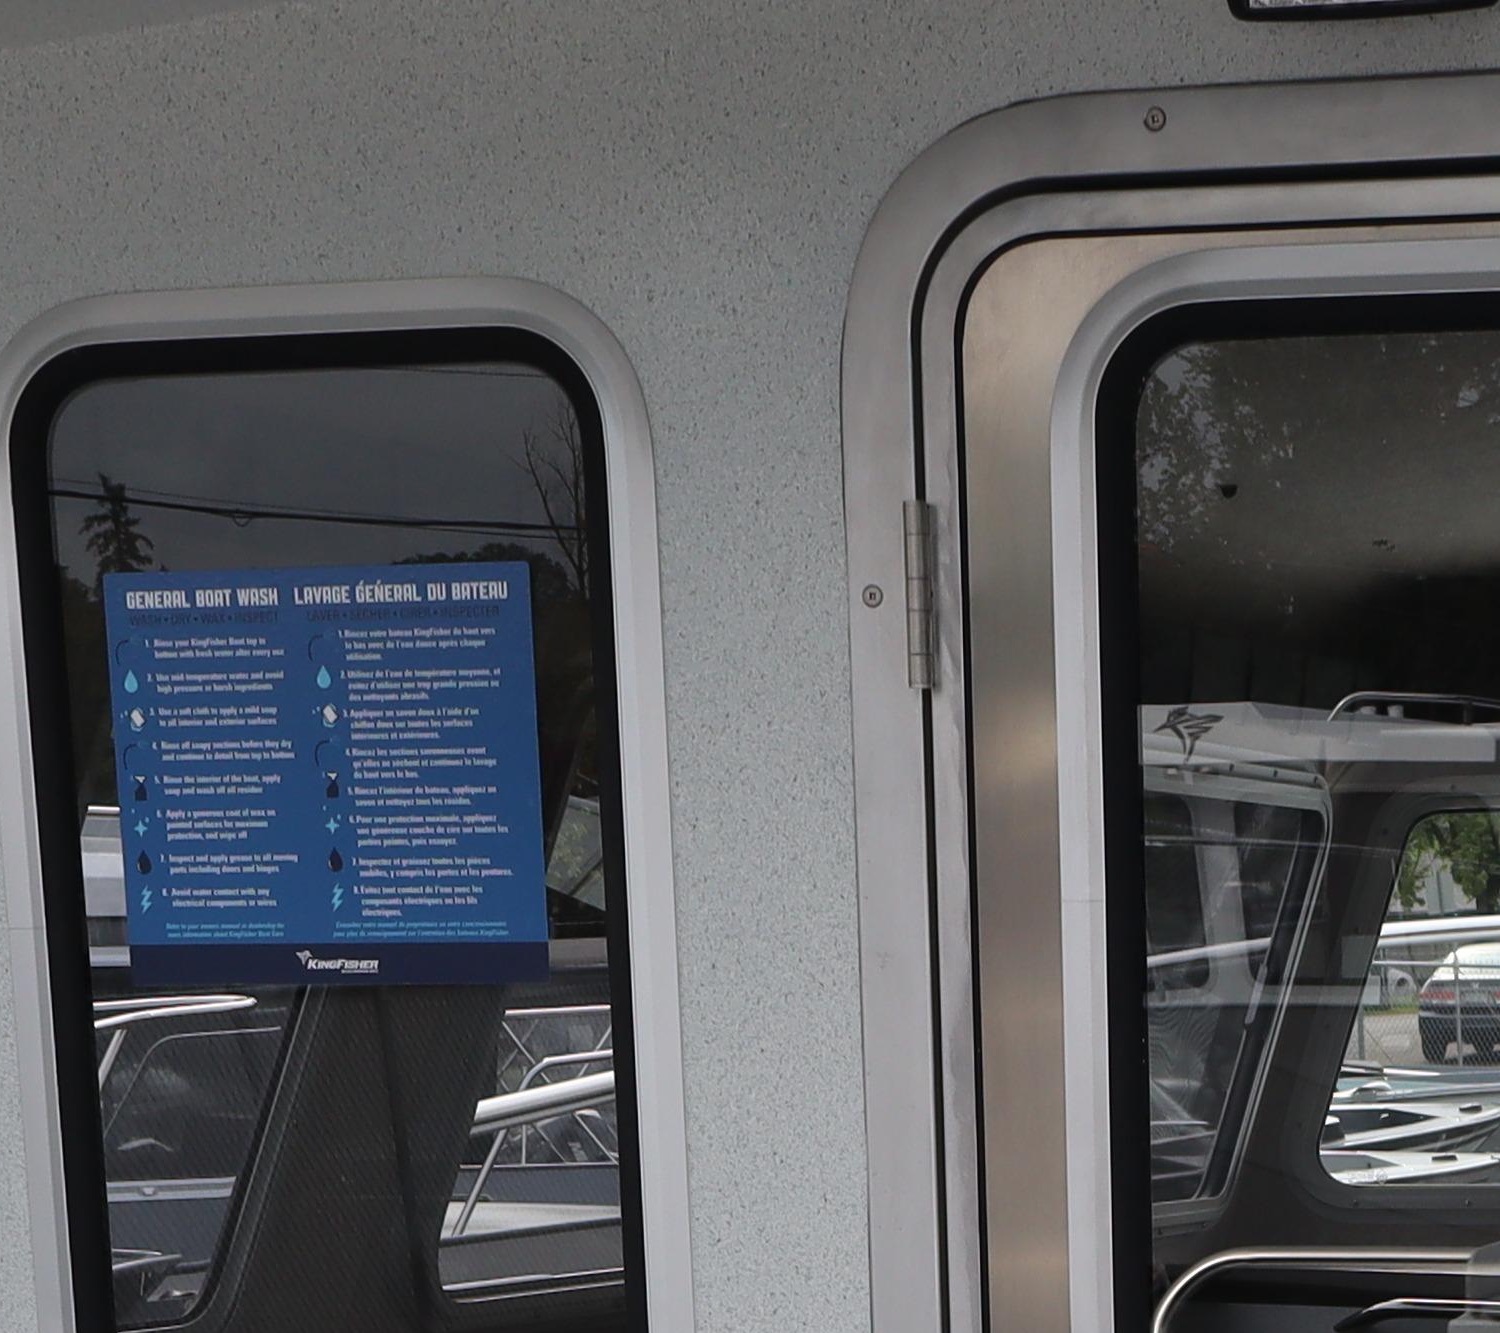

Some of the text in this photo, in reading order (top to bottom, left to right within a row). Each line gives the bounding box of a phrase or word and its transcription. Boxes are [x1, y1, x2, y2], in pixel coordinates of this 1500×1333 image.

[126, 587, 279, 609] GENERAL BOAT WASH
[293, 585, 350, 604] LAVAGE
[425, 582, 444, 601] DU
[450, 581, 507, 600] BATEAU
